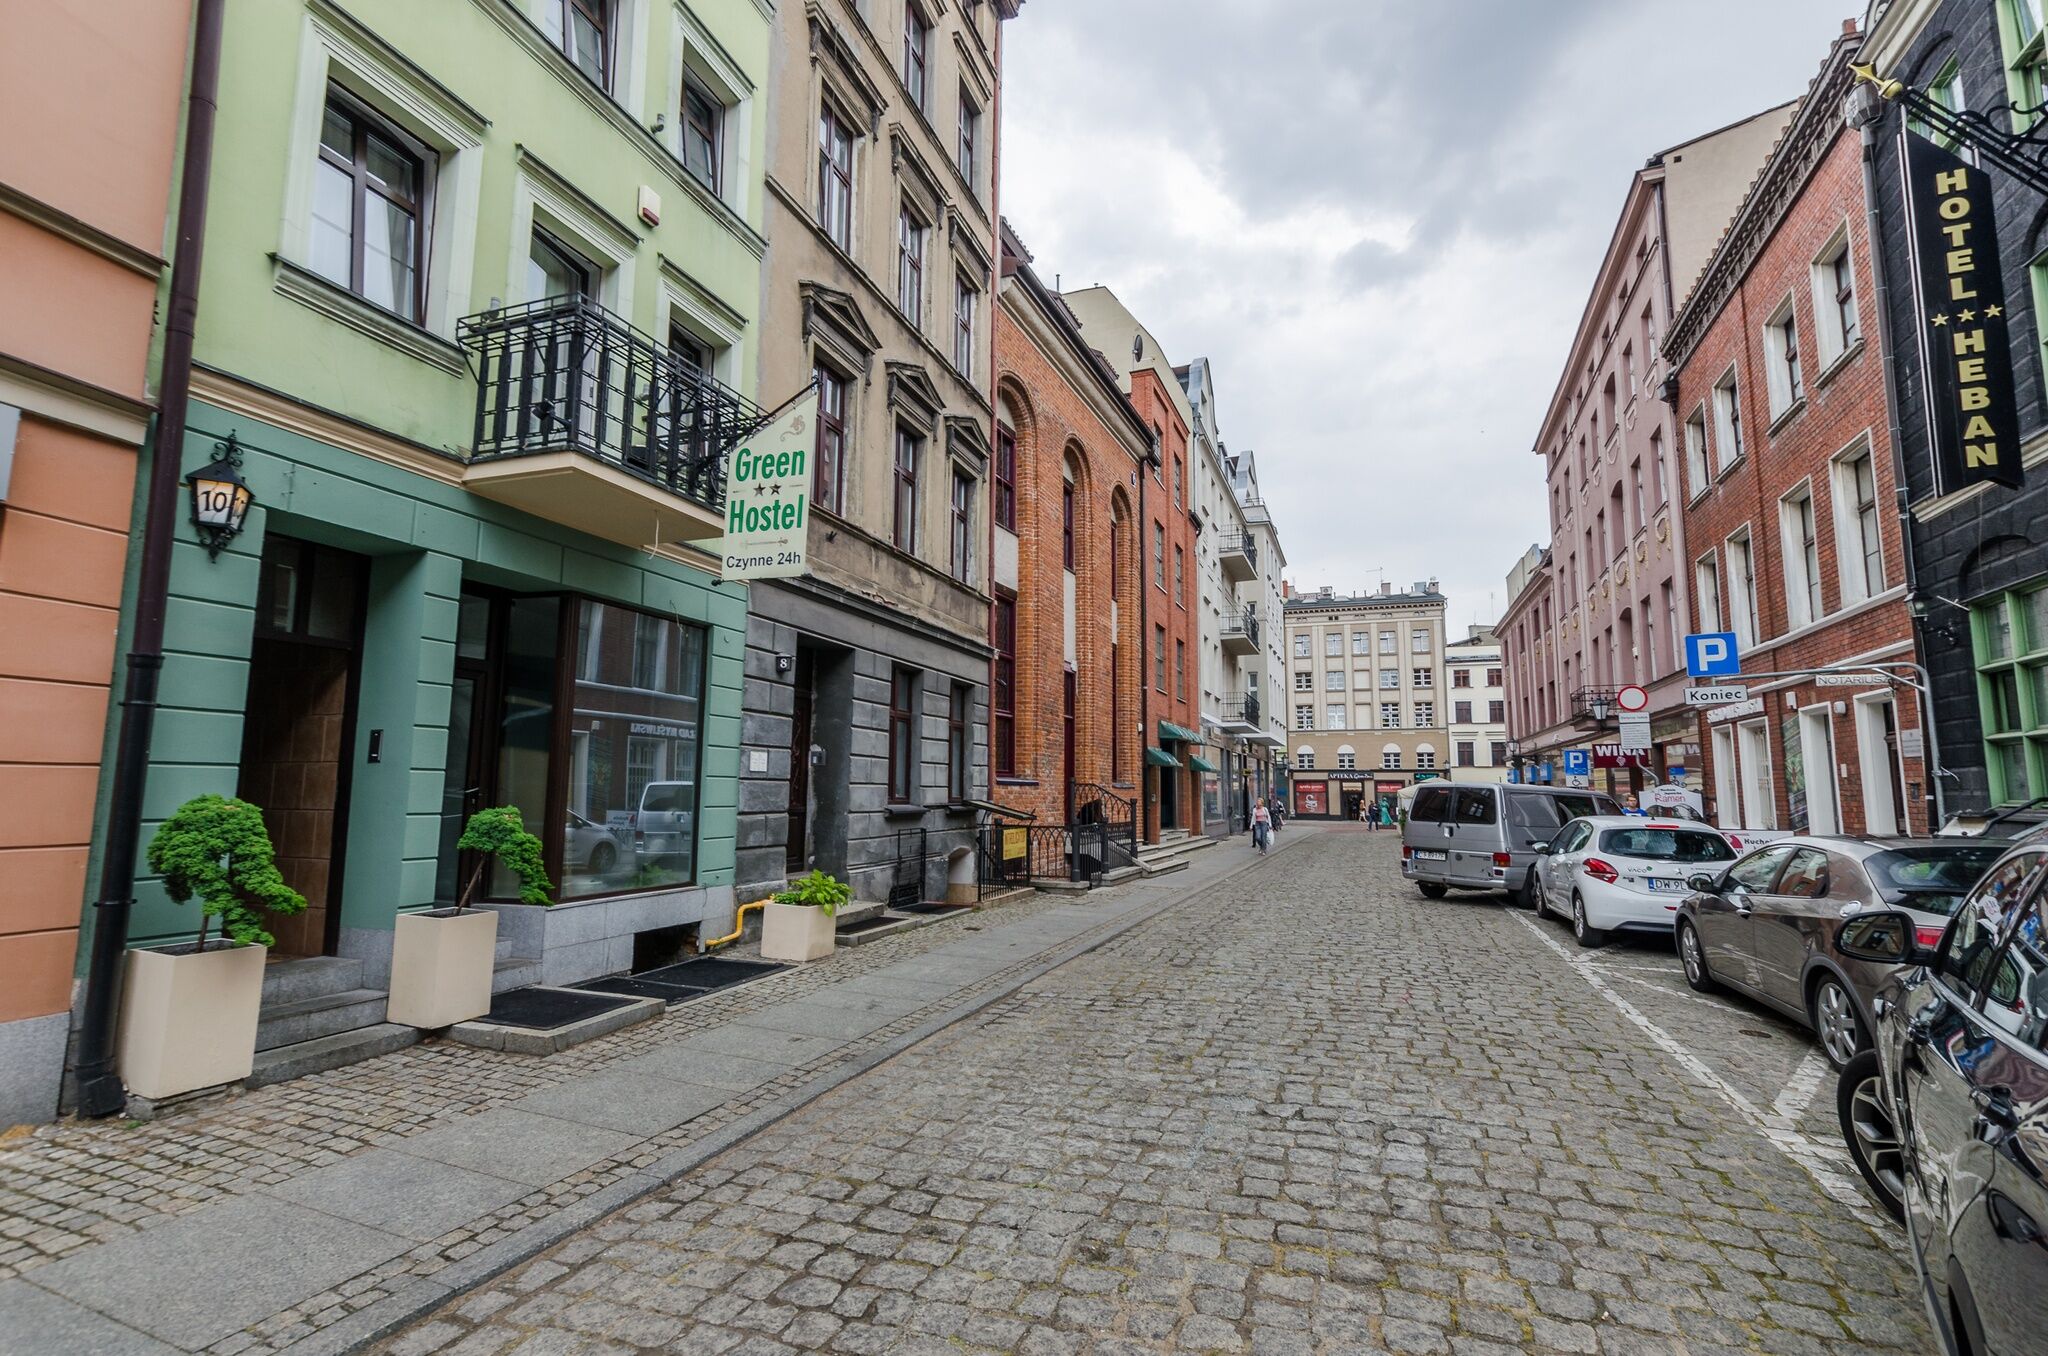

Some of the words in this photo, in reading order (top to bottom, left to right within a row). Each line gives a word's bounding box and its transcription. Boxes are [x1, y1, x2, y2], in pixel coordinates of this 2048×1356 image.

[1935, 167, 1977, 301] HOTEL
[1953, 328, 1999, 468] HEBAN
[735, 447, 805, 482] Green
[201, 490, 227, 513] 10
[729, 494, 804, 534] Hostel
[726, 554, 773, 571] Czynne
[777, 552, 801, 565] 24h
[780, 658, 787, 669] 8
[1697, 637, 1727, 671] P
[1817, 676, 1889, 685] NOTARIUSZ
[1690, 689, 1742, 701] Koniec
[1569, 752, 1583, 768] P
[1654, 792, 1686, 803] Ramen
[1655, 880, 1670, 889] DW
[1674, 881, 1687, 891] 9L
